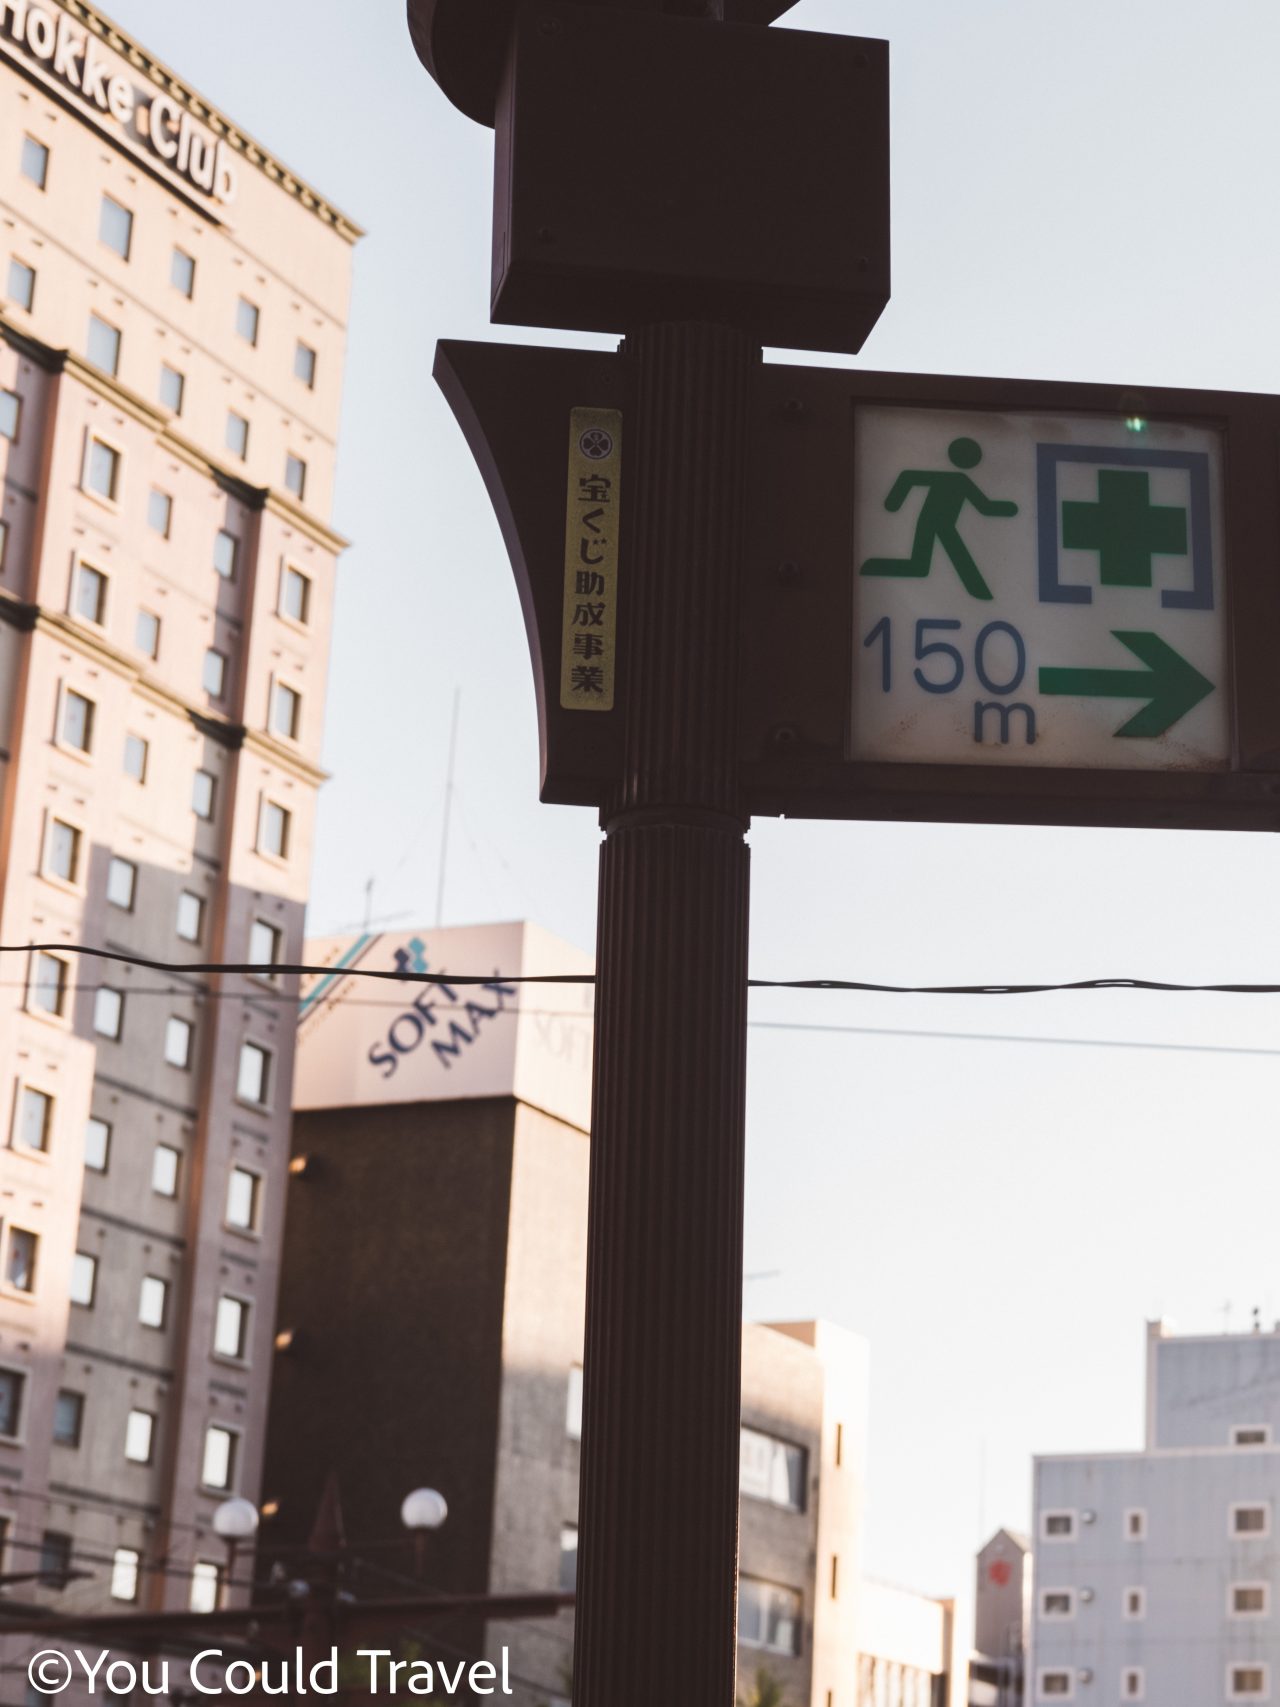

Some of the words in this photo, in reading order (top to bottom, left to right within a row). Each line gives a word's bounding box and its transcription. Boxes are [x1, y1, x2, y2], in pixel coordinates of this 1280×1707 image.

[149, 95, 237, 204] Club
[571, 473, 612, 694] 宝くじ助成事業
[863, 616, 1027, 695] 150
[973, 701, 1036, 745] m
[367, 967, 458, 1079] SOFT
[430, 967, 517, 1070] MAX
